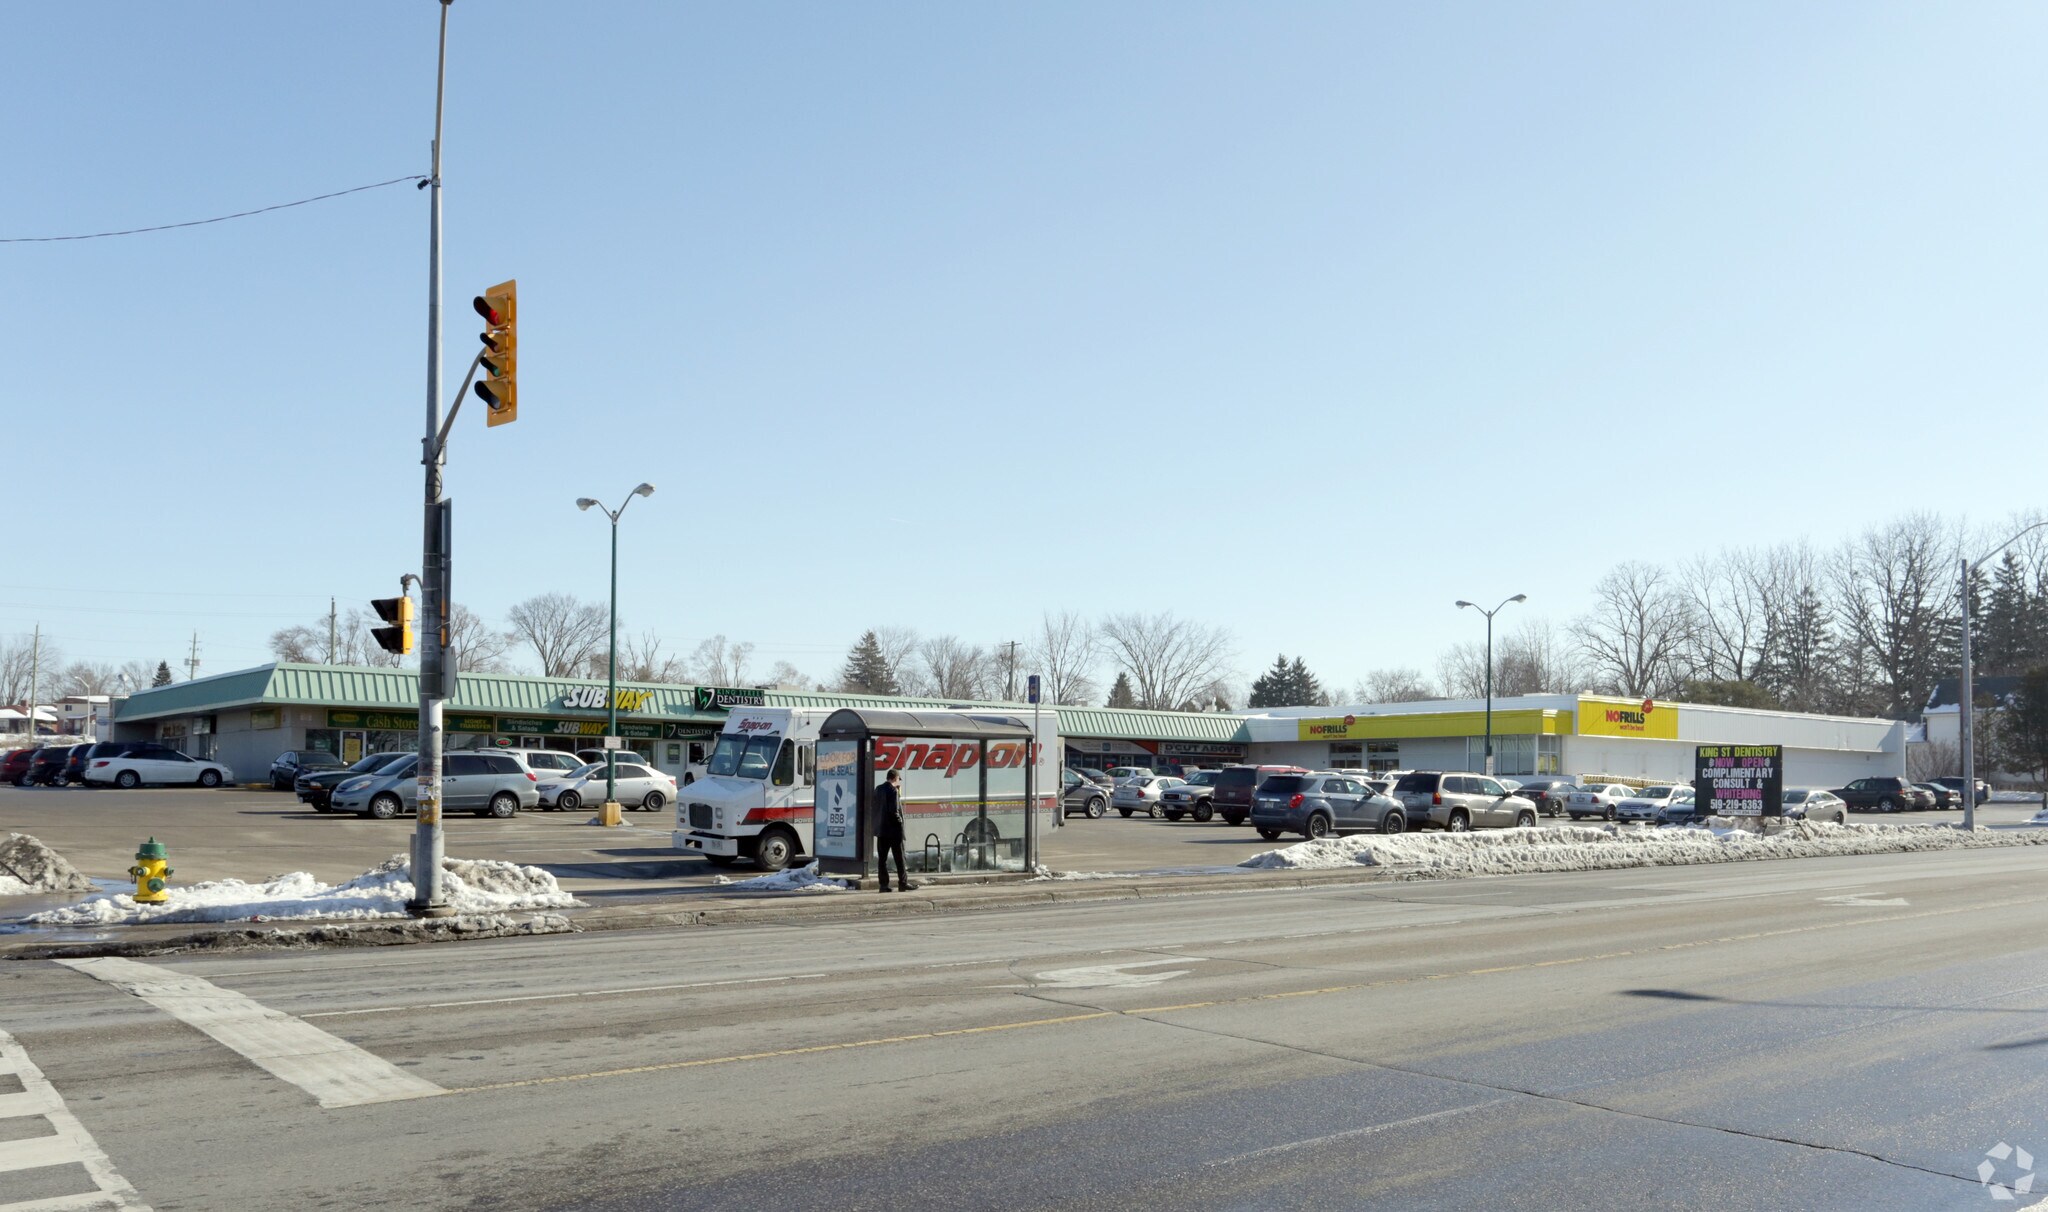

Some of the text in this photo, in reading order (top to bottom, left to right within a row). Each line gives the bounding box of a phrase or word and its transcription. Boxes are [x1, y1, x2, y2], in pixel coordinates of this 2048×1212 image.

[563, 688, 653, 710] SUBWAY
[717, 695, 764, 705] DENTISTRY
[366, 714, 391, 728] Cash
[393, 716, 419, 729] Store
[554, 721, 608, 734] SUBWAY
[1201, 745, 1240, 753] ABOVE
[1700, 746, 1778, 757] KING ST DENTISTRY
[842, 752, 856, 762] FOR
[1715, 758, 1764, 767] NOW OPEN
[837, 765, 855, 776] SEAL
[1702, 768, 1773, 778] COMPLIMENTARY
[1713, 779, 1763, 789] CONSULT &
[1716, 789, 1761, 799] WHITENING
[1710, 799, 1762, 810] 519-219-6363
